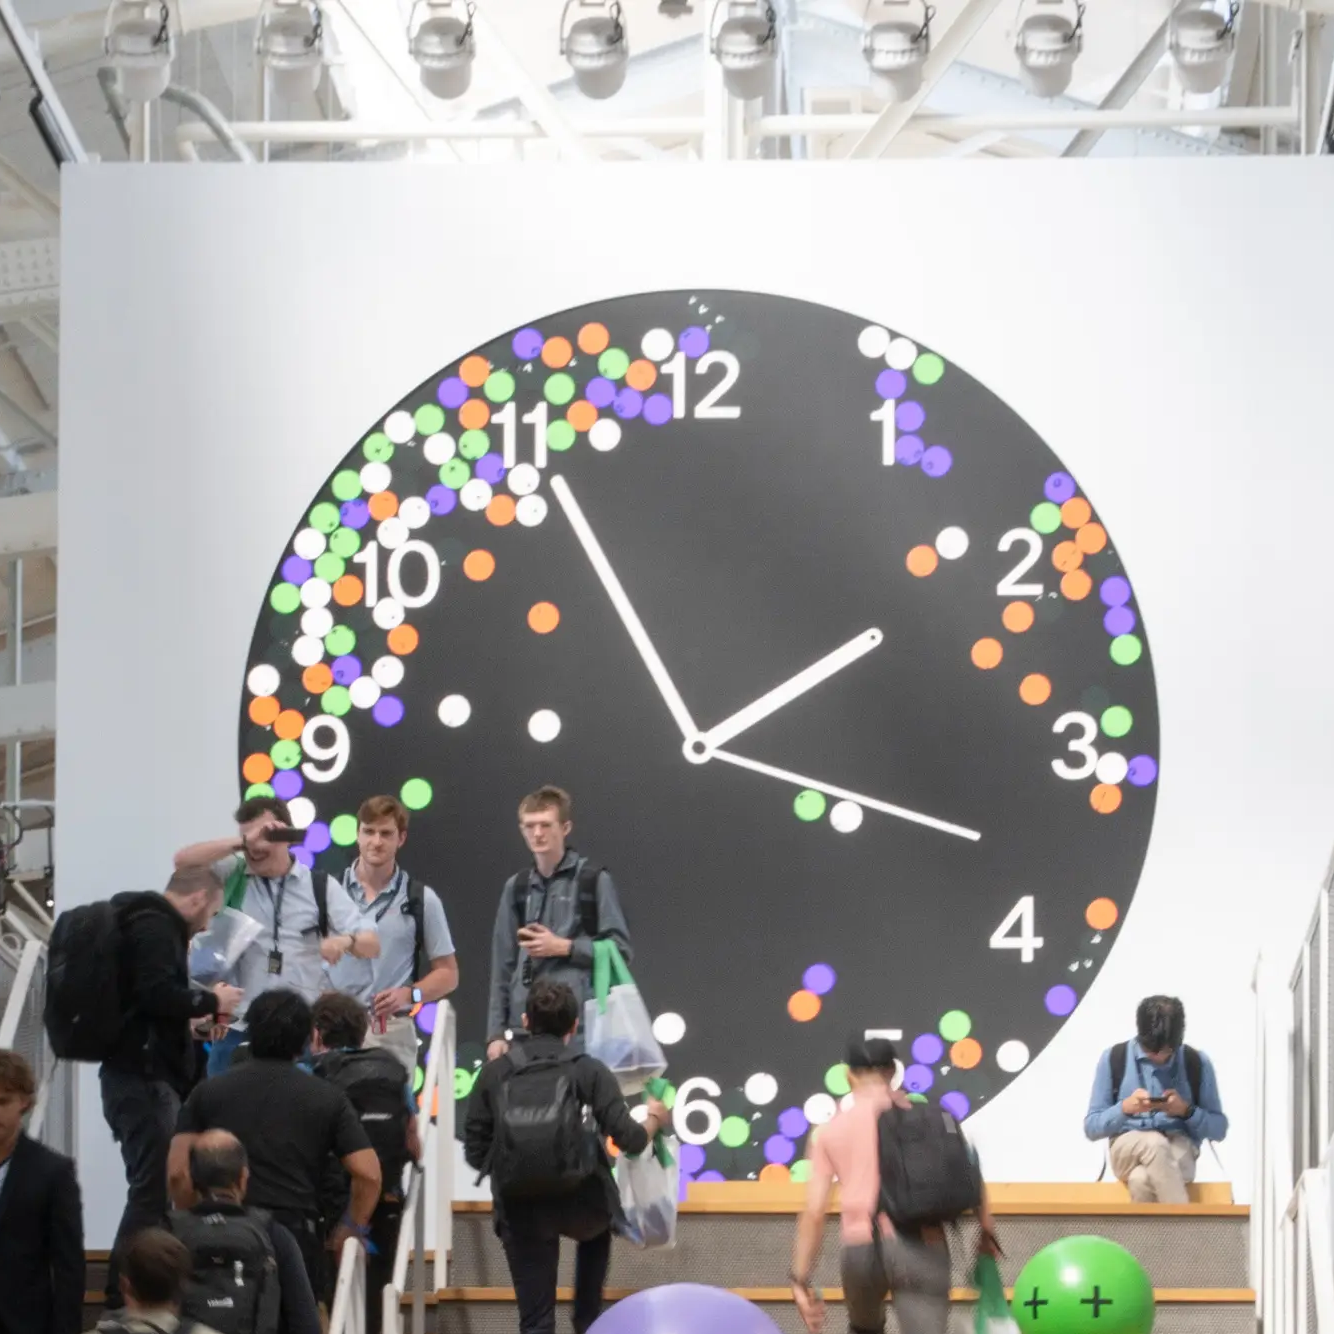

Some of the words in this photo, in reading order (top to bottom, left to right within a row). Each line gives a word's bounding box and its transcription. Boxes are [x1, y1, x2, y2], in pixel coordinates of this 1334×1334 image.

[659, 349, 742, 419] 12
[490, 400, 548, 469] 11
[869, 397, 897, 466] 1
[352, 539, 441, 609] 10
[996, 539, 1044, 600] 2
[300, 714, 351, 783] 9
[1051, 711, 1099, 781] 3
[989, 895, 1044, 963] 4
[672, 1076, 723, 1146] 6
